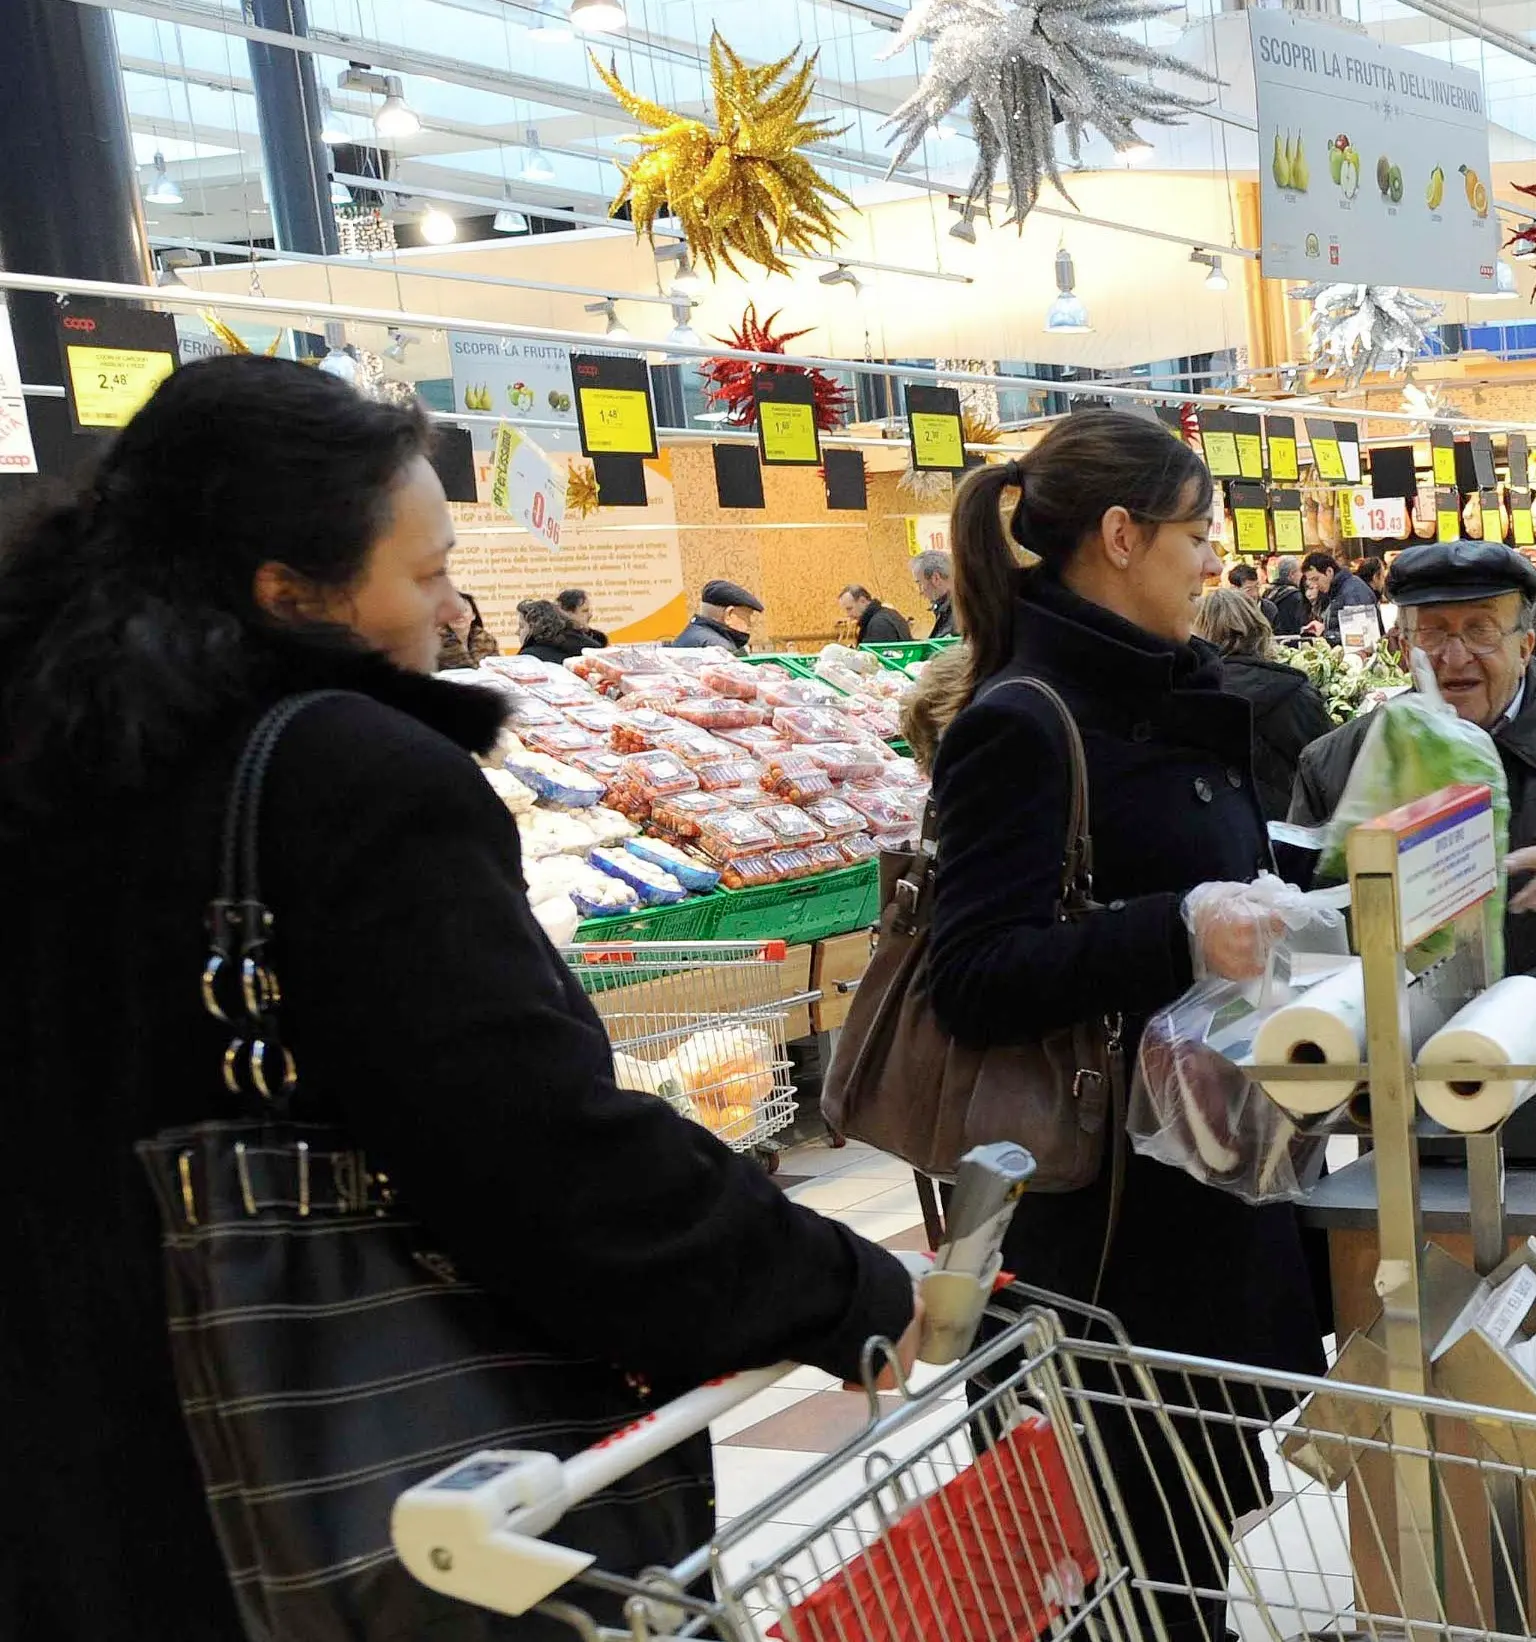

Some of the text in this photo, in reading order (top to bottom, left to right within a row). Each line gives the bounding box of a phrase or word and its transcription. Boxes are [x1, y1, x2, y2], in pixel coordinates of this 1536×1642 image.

[1259, 35, 1317, 73] SCOPRI
[1323, 50, 1343, 78] LA
[1346, 57, 1396, 92] FRUTTA
[63, 316, 96, 332] coop
[455, 341, 500, 356] SCOPRI
[523, 346, 567, 360] FRUTTA
